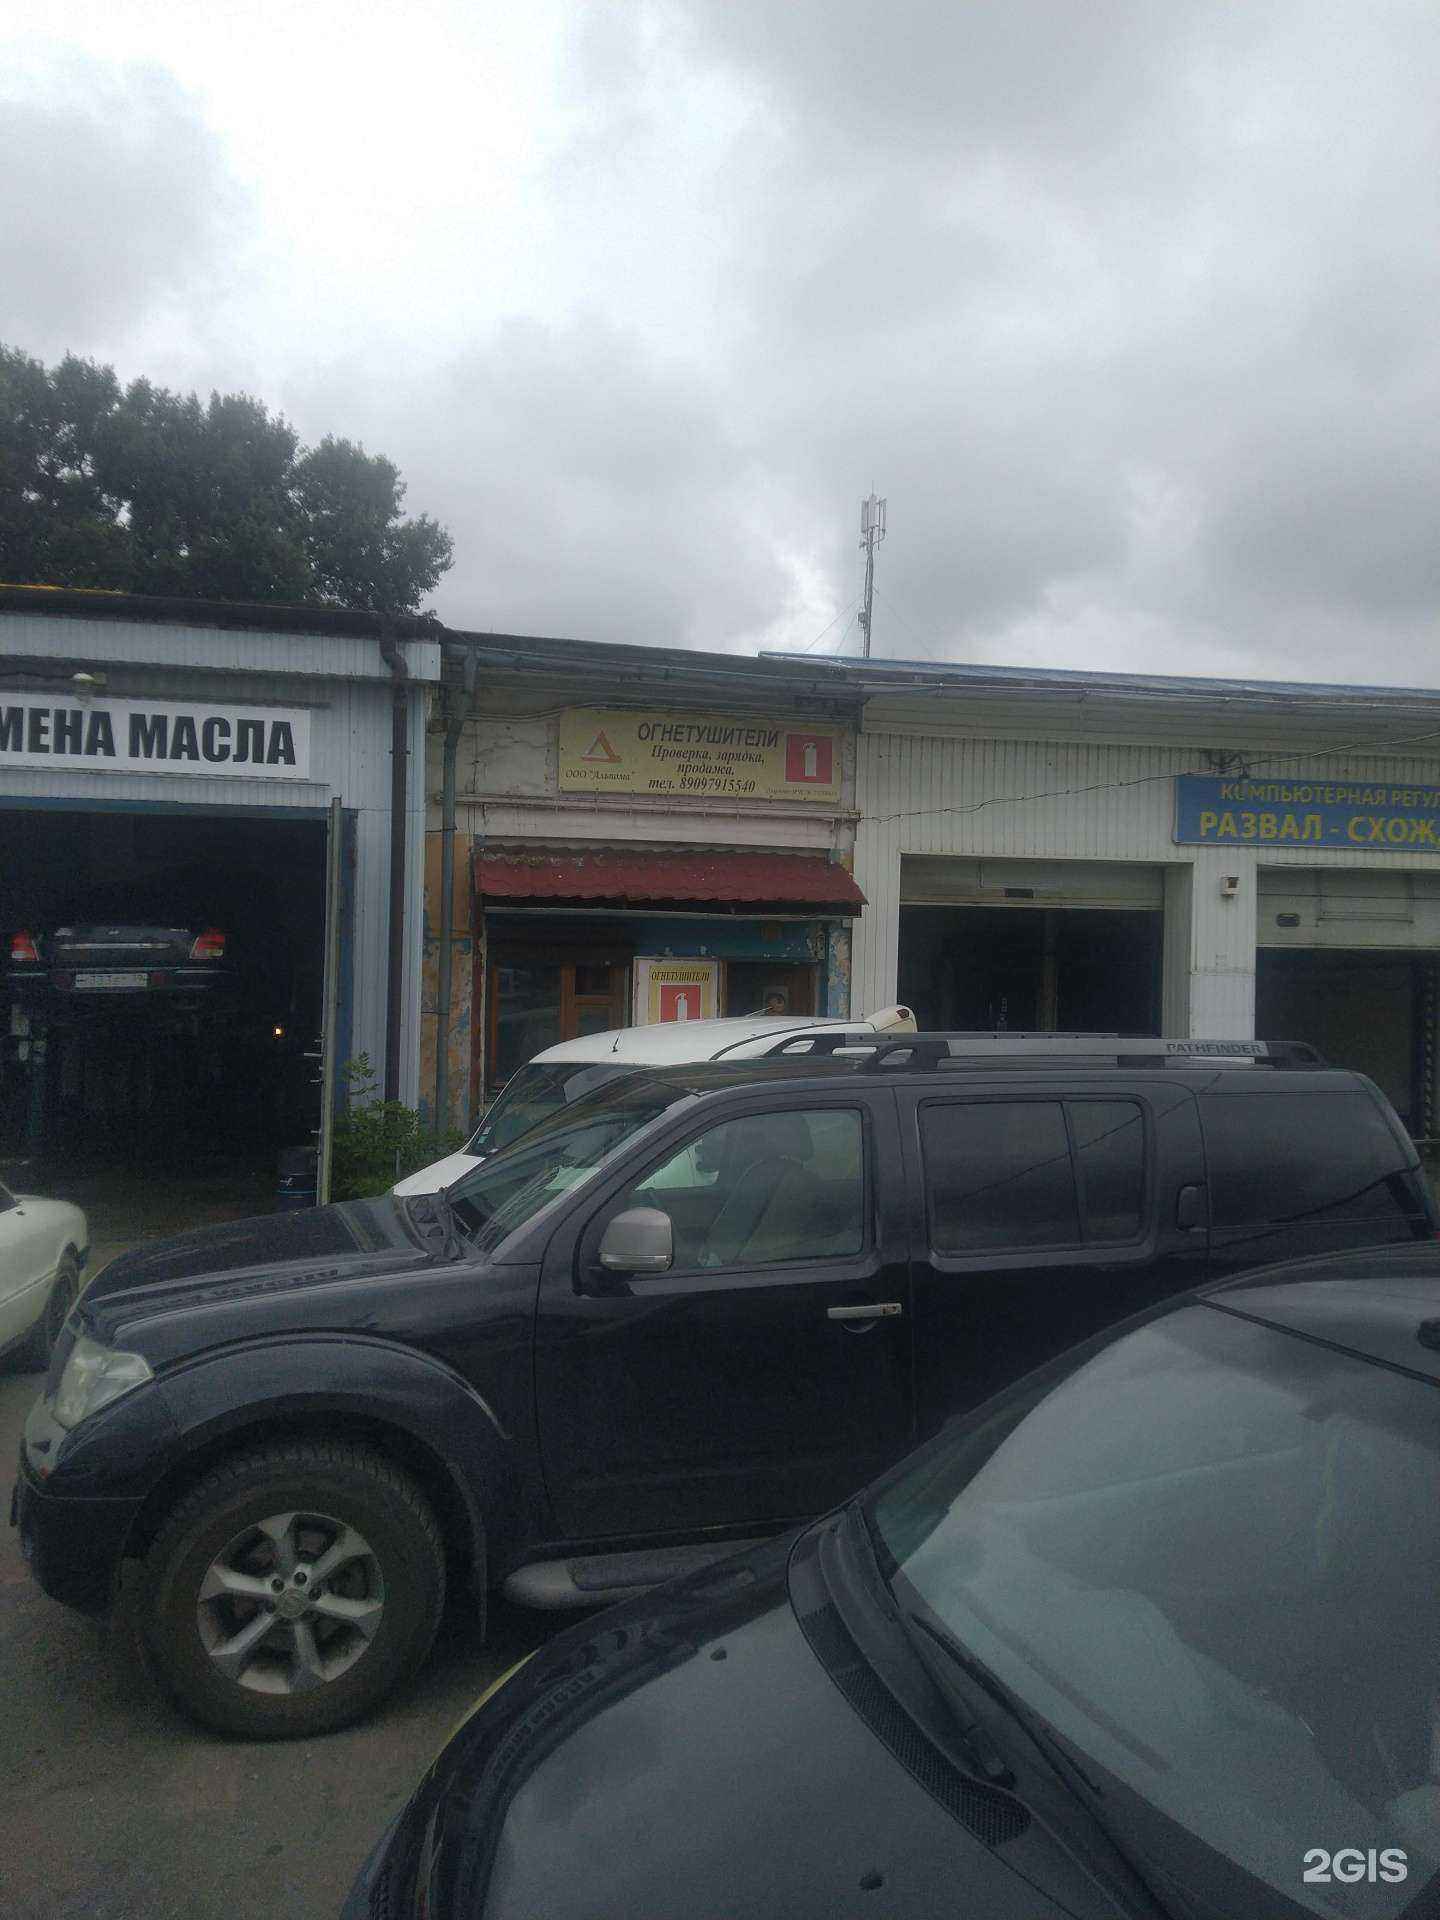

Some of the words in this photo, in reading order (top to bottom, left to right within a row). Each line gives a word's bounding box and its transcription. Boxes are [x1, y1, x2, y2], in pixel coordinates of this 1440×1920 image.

[127, 712, 297, 766] МАСЛА
[637, 722, 779, 748] ОГНЕТУШИТЕЛИ
[651, 744, 712, 762] Проверка,
[716, 749, 765, 767] зарядка,
[565, 769, 587, 779] ООО
[648, 778, 676, 790] тел.
[679, 776, 756, 793] 89097915540
[1221, 783, 1387, 806] КОМПЬЮТЕРНАЯ
[1200, 811, 1322, 841] РАЗВАЛ
[1166, 1043, 1264, 1055] PATHFINDER
